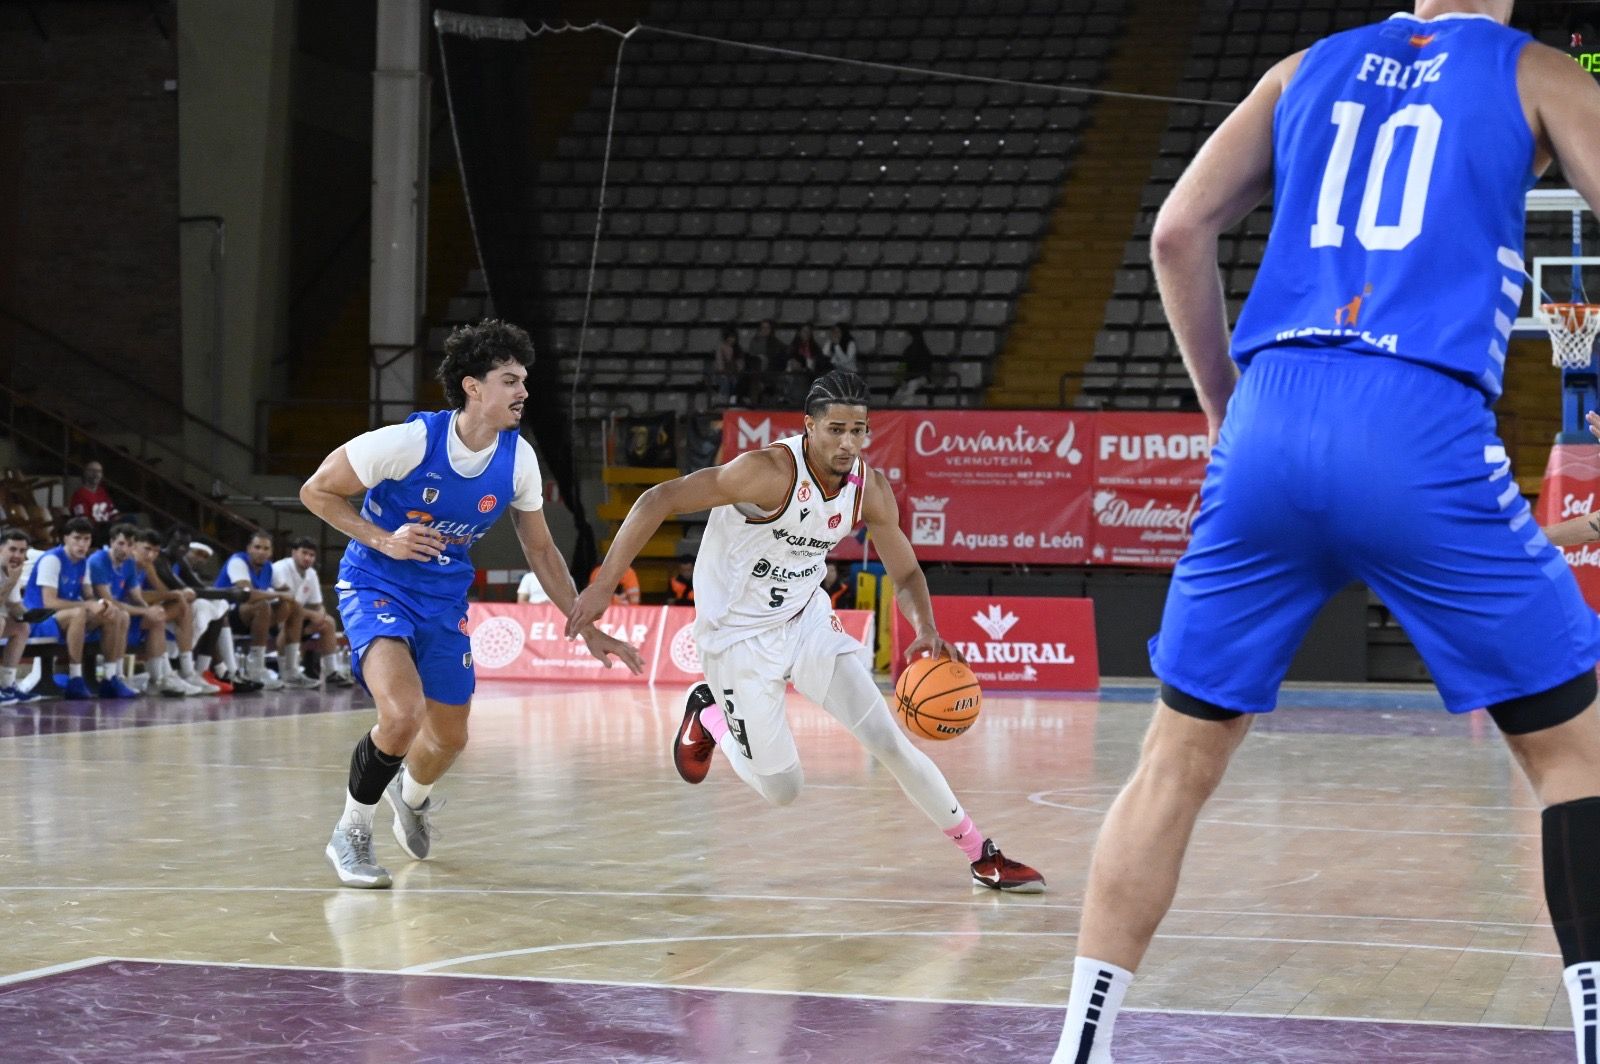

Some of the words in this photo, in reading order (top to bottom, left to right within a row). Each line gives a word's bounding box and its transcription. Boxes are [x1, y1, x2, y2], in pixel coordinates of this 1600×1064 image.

[1356, 52, 1449, 89] FRITZ
[1310, 101, 1443, 250] 10
[915, 420, 1053, 456] Cervantes
[1561, 493, 1595, 518] Sed
[952, 531, 1009, 549] Aguas
[1013, 531, 1035, 548] de
[1040, 531, 1084, 548] León
[769, 586, 789, 608] 5
[530, 622, 558, 641] EL
[985, 641, 1075, 664] RURAL
